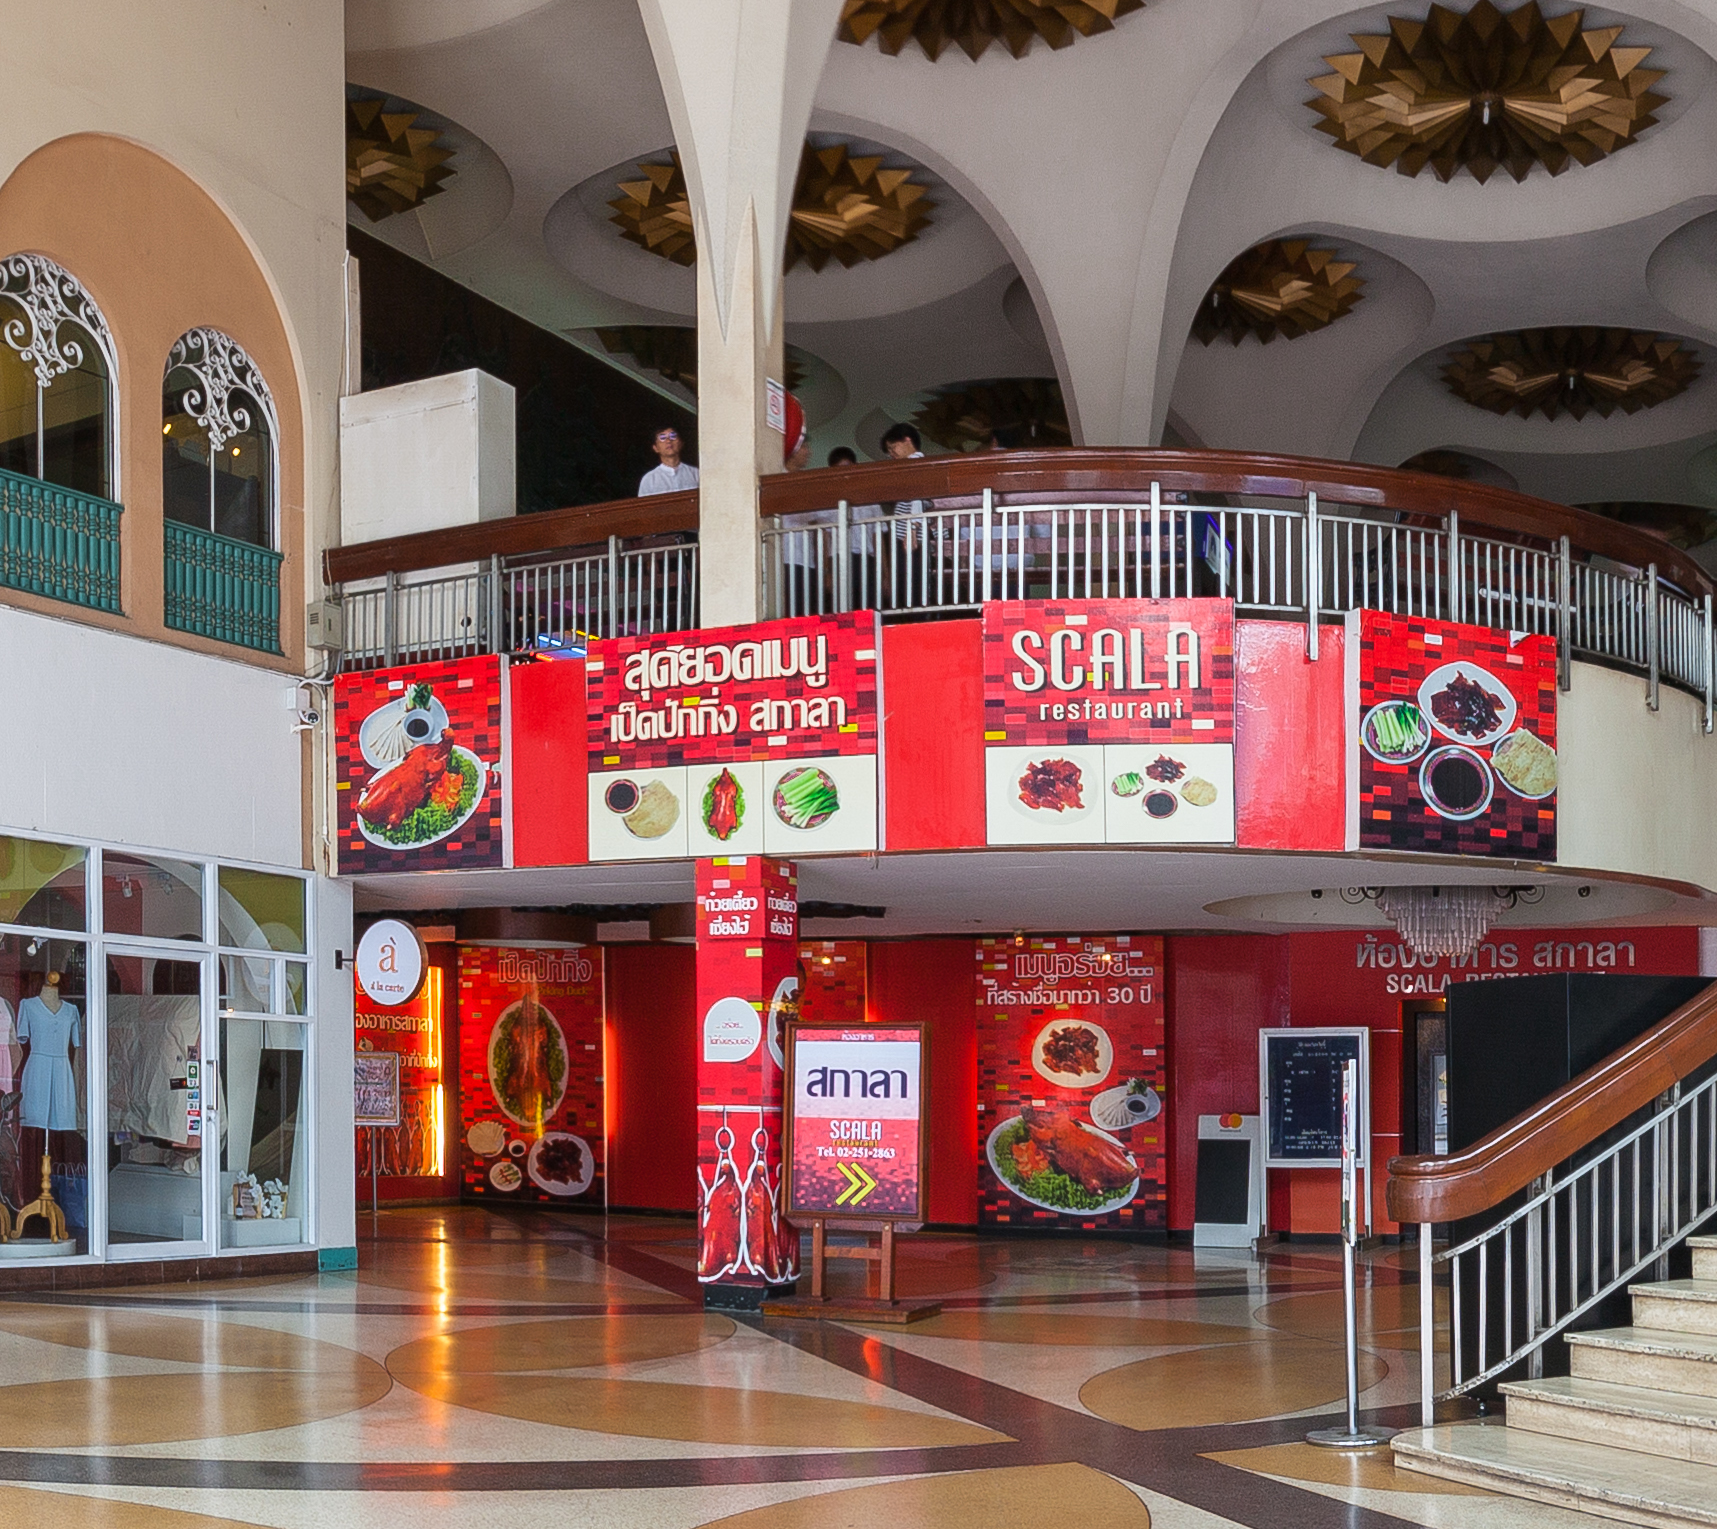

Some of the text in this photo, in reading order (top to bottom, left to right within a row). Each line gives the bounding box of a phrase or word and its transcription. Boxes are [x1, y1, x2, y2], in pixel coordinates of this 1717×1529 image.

[624, 635, 828, 702] สุดยอดเมนู
[1012, 628, 1200, 692] SCALA
[610, 686, 847, 743] เป็ดปักกิ่ง สกาลา
[1039, 698, 1183, 720] restaurant
[1533, 941, 1635, 968] สกาลา
[1107, 987, 1134, 1004] 30
[1140, 983, 1152, 1005] ปี
[806, 1066, 908, 1099] สกาลา
[829, 1120, 882, 1141] SCALA
